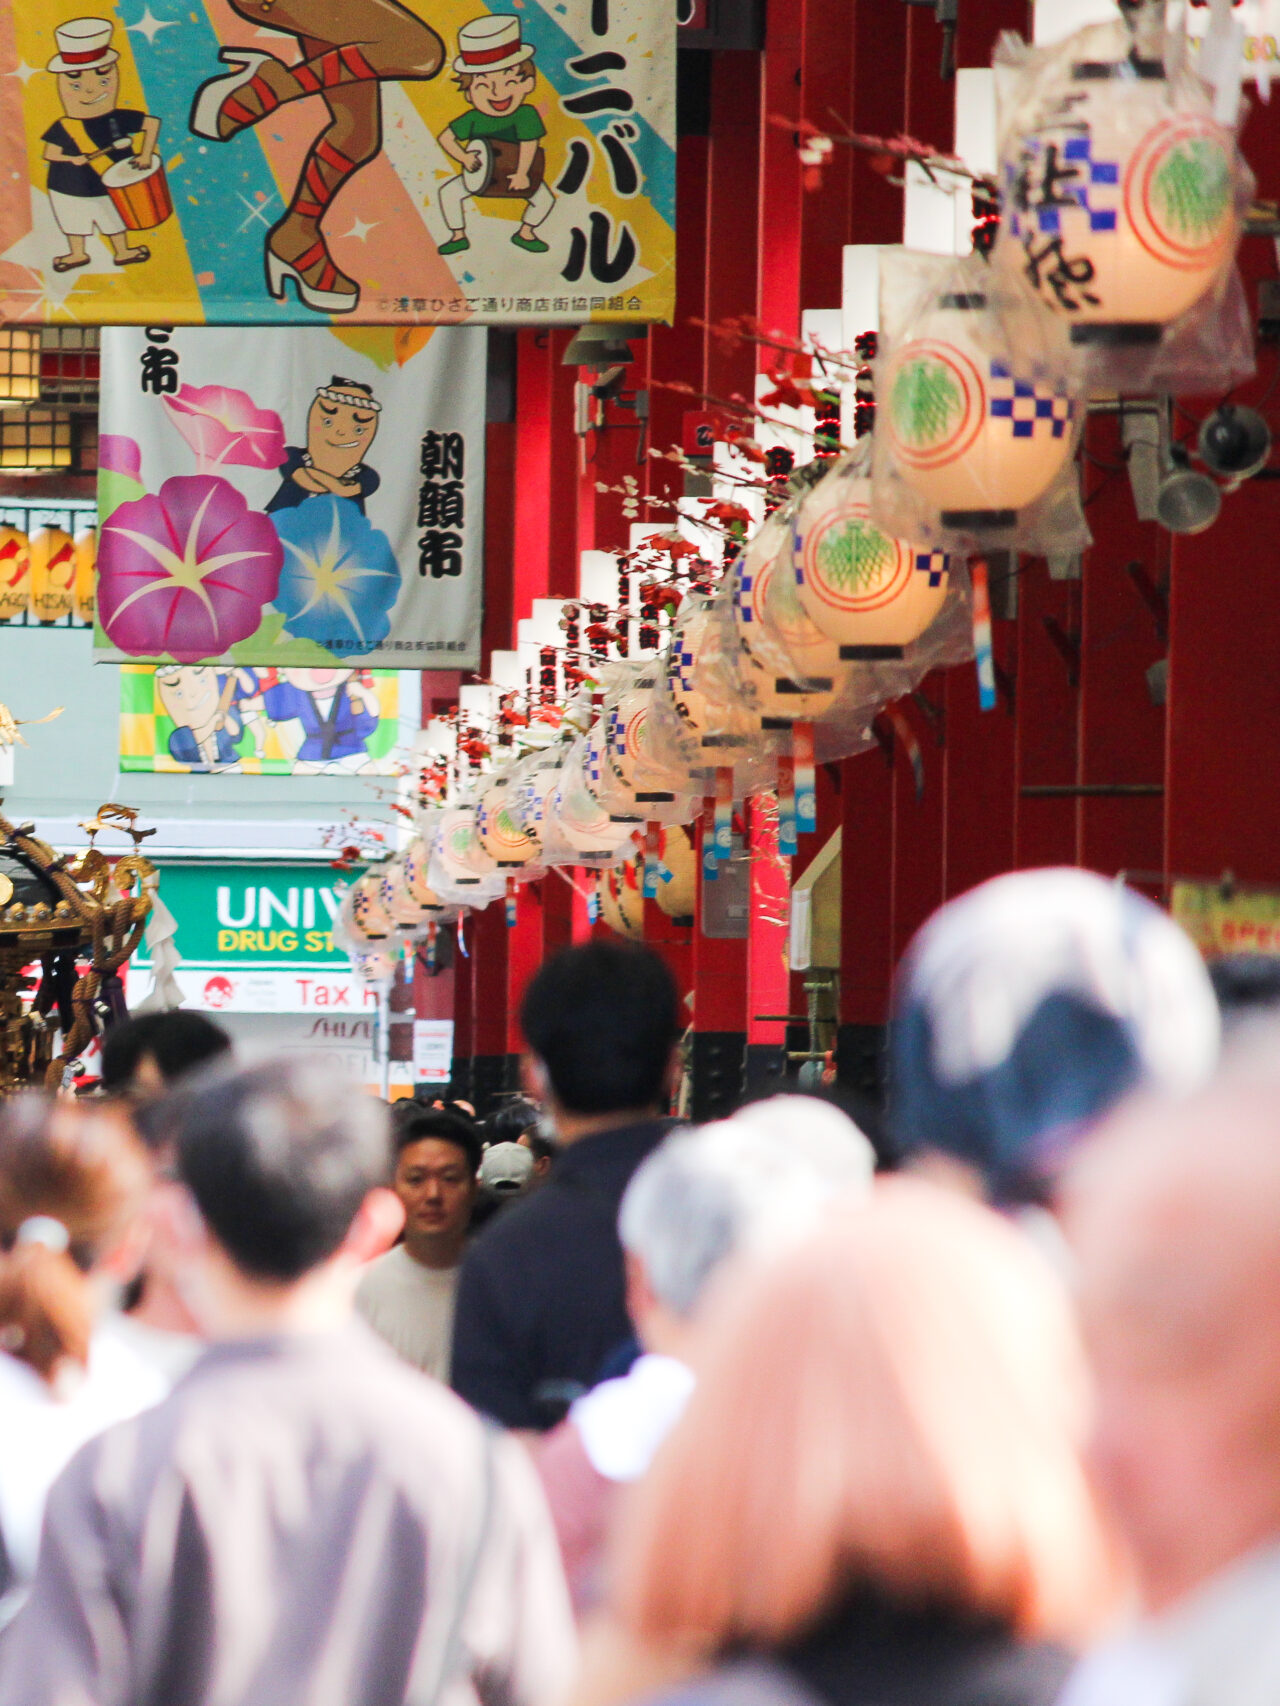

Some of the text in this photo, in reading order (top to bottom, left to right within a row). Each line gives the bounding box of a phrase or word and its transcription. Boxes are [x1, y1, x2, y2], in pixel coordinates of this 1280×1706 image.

[418, 430, 464, 579] 朝顔市
[217, 930, 299, 952] DRUG
[295, 979, 349, 1006] Tax
